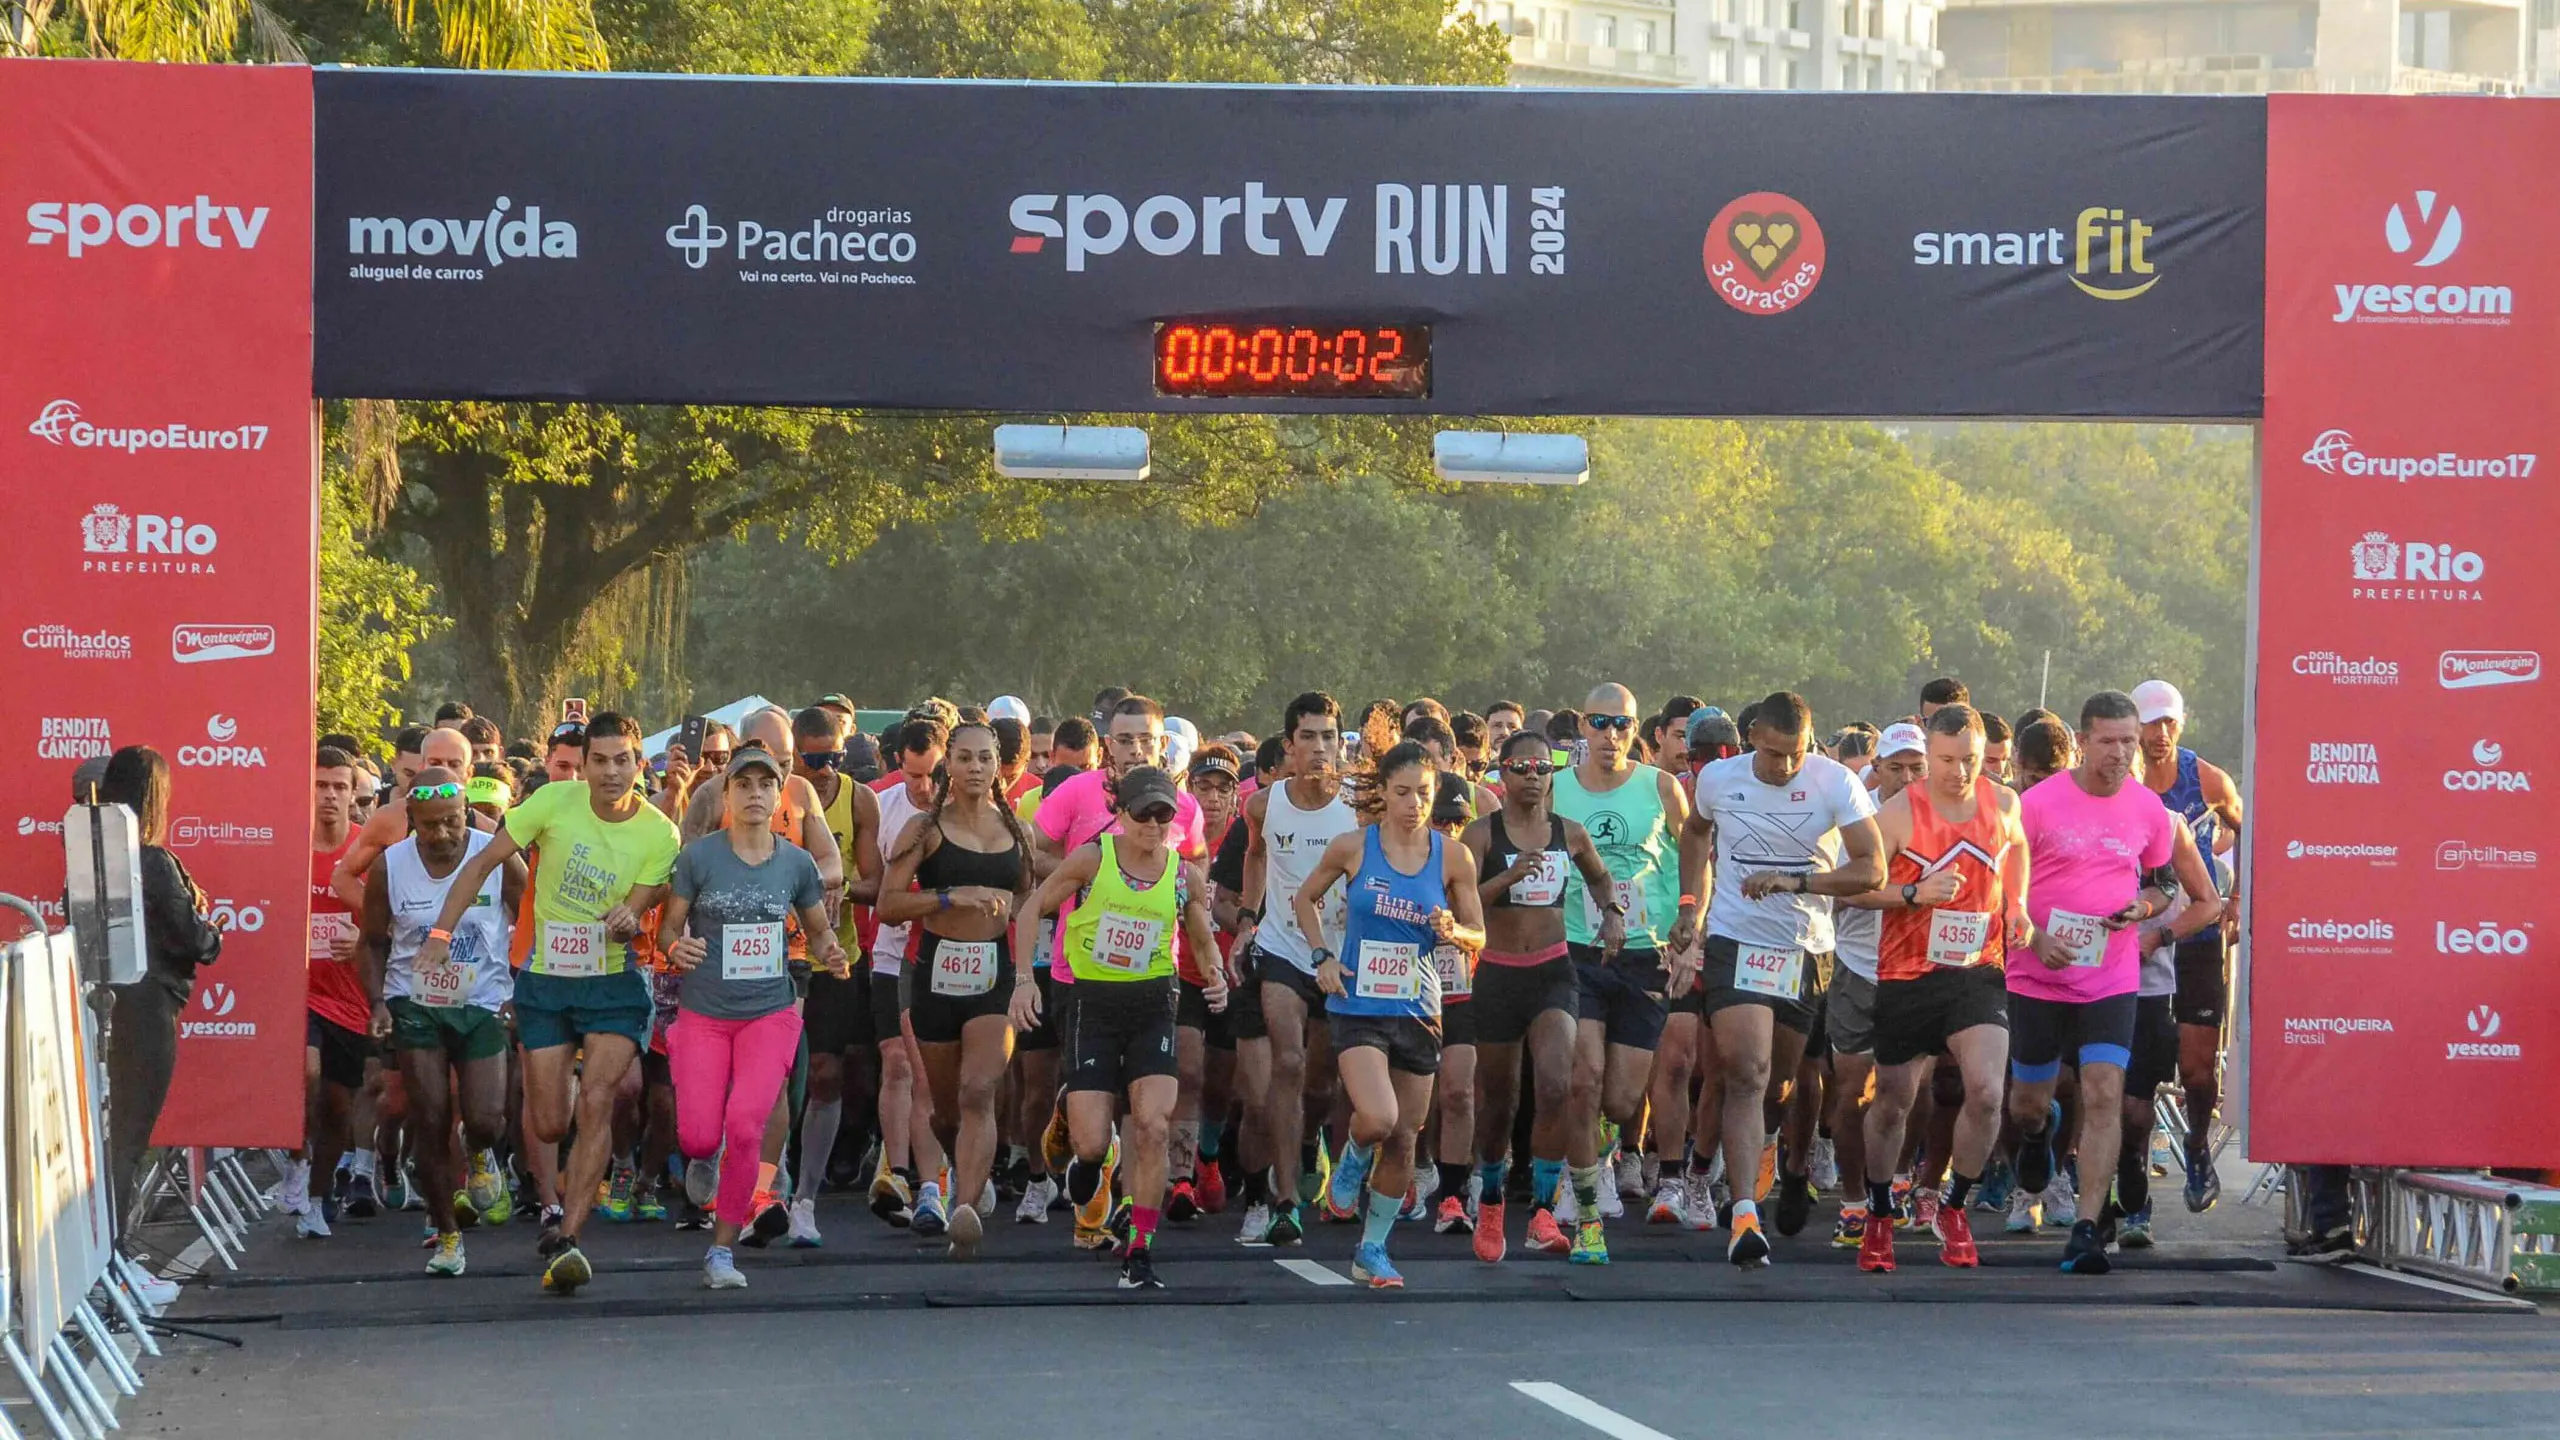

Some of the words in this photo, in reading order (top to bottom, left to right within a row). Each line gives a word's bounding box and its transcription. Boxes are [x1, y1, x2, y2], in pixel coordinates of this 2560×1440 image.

[27, 195, 270, 257] sportv
[827, 206, 911, 226] drogarias
[349, 196, 577, 267] movida
[1009, 182, 1348, 272] sportv
[1375, 183, 1507, 275] RUN
[1530, 185, 1565, 275] 2024
[738, 219, 916, 262] Pacheco
[1913, 227, 2063, 265] smart
[2075, 207, 2154, 274] fit
[350, 264, 408, 282] aluguel
[412, 264, 432, 279] de
[435, 266, 484, 280] carros
[739, 271, 759, 282] Vai
[762, 273, 778, 282] na
[781, 271, 816, 283] certa.
[820, 272, 839, 283] Vai
[842, 274, 858, 284] na
[861, 272, 916, 285] Pacheco.
[1712, 260, 1734, 278] 3
[1721, 261, 1817, 309] corações
[2333, 284, 2512, 322] yescom
[1164, 327, 1402, 382] 00:00:02
[69, 422, 268, 454] GrupoEuro17
[2342, 452, 2536, 483] GrupoEuro17
[137, 515, 217, 555] Rio
[83, 561, 216, 574] PREFEITURA
[2405, 542, 2484, 582] Rio
[2353, 588, 2482, 601] PREFEITURA
[22, 629, 131, 650] Cunhados
[39, 625, 65, 634] DOIS
[64, 649, 131, 659] HORTIFRUTI
[2309, 651, 2334, 661] DOIS
[2292, 655, 2398, 676] Cunhados
[2333, 675, 2398, 685] HORTIFRUTI
[41, 718, 111, 738] BENDITA
[37, 736, 112, 760] CÂNFORA
[177, 746, 266, 768] COPRA
[2309, 743, 2377, 763] BENDITA
[2306, 761, 2380, 784] CÂNFORA
[2443, 770, 2531, 792] COPRA
[179, 822, 273, 839] antilhas
[572, 843, 591, 860] SE
[2306, 844, 2397, 858] espaçolaser
[2444, 846, 2537, 863] antilhas
[564, 870, 597, 889] VALE
[567, 858, 616, 886] CUIDAR
[1376, 893, 1414, 910] ELITE
[1375, 904, 1430, 925] RUNNERS
[312, 925, 337, 940] 630
[1106, 927, 1145, 950] 1509
[1939, 925, 1977, 943] 4356
[2054, 924, 2094, 946] 4475
[2287, 917, 2394, 942] cinépolis
[2436, 921, 2527, 954] leão
[551, 936, 589, 954] 4228
[732, 938, 770, 956] 4253
[941, 955, 981, 974] 4612
[1367, 957, 1408, 976] 4026
[1746, 953, 1786, 973] 4427
[180, 1021, 256, 1038] yescom
[2284, 1017, 2394, 1034] MANTIQUEIRA
[2284, 1032, 2325, 1044] Brasil
[2446, 1042, 2521, 1060] yescom
